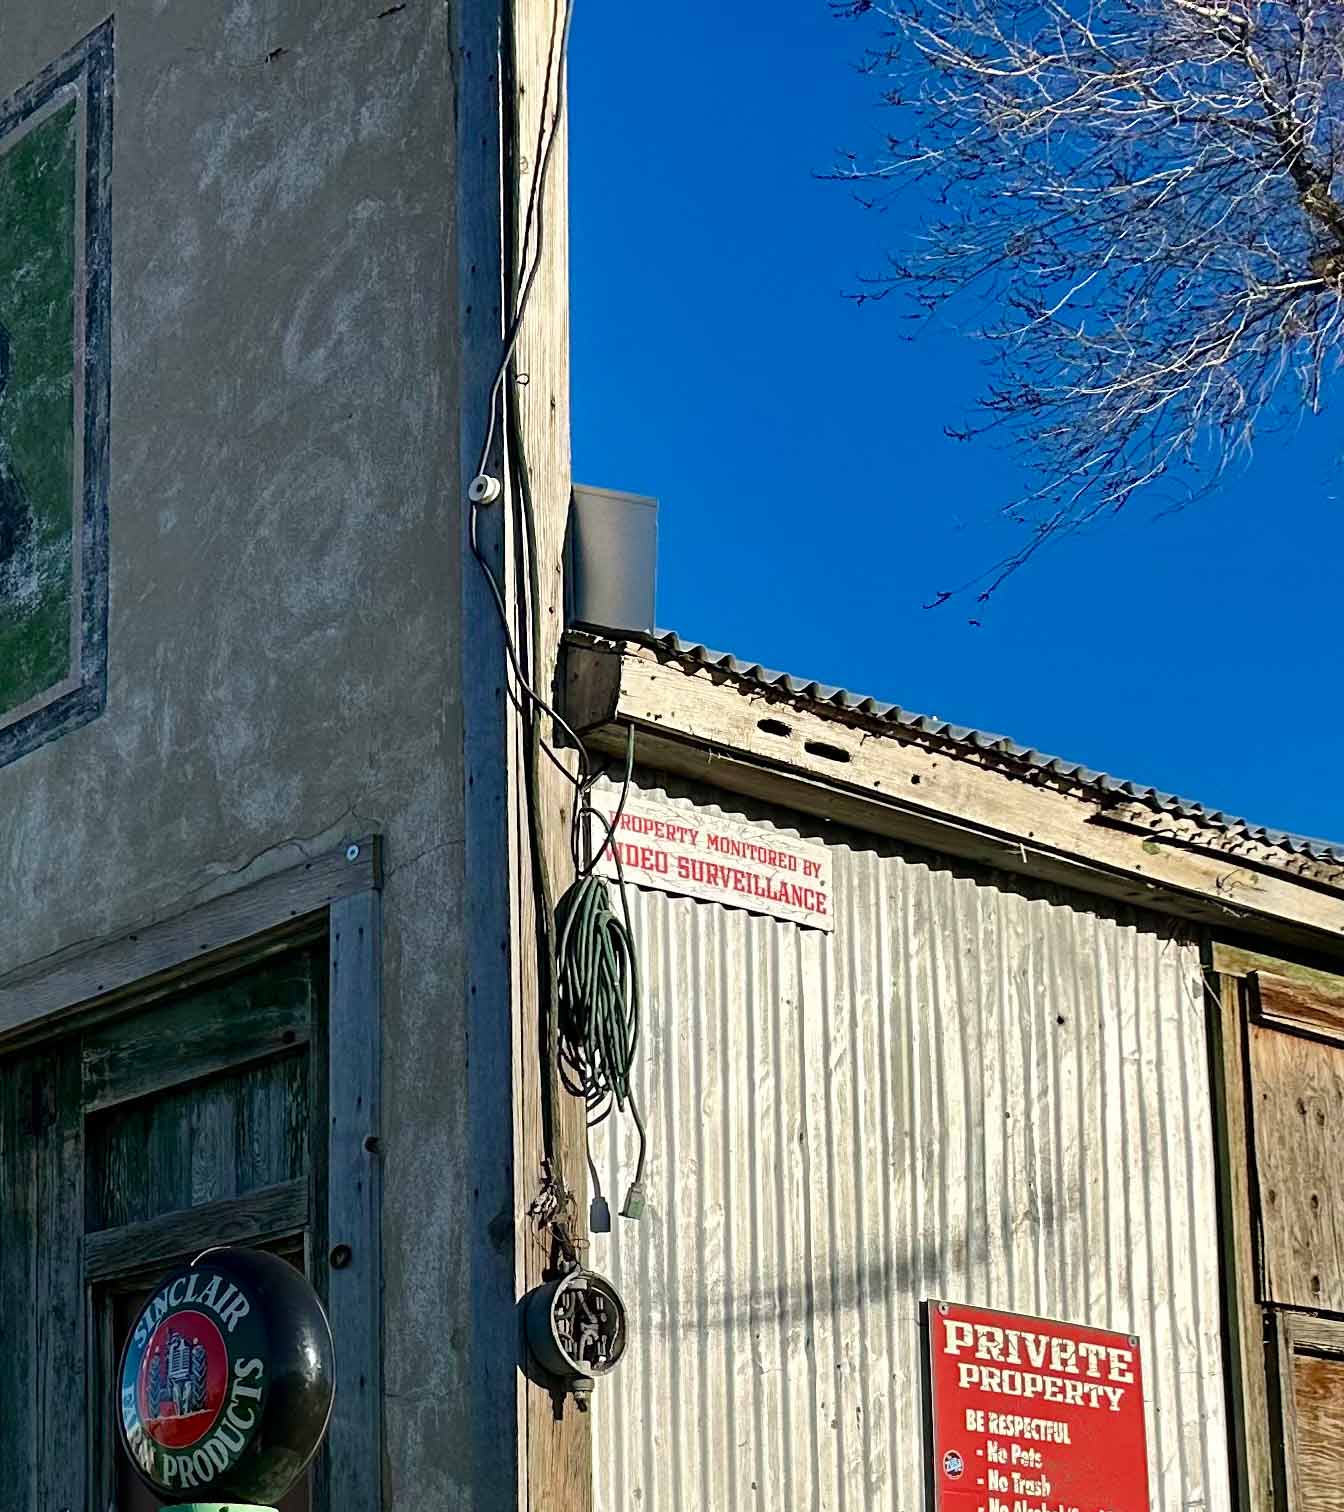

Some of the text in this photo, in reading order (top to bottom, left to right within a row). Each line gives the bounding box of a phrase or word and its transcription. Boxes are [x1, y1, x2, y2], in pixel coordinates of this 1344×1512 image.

[707, 833, 799, 873] MONITORED
[803, 858, 823, 879] BY
[677, 855, 827, 915] SURVEILLANCE
[133, 1273, 250, 1349] SINCLAIR
[943, 1319, 1135, 1384] PRIVATE
[958, 1362, 1125, 1411] PROPERTY
[162, 1358, 264, 1489] PRODUCTS
[965, 1408, 1072, 1445] BE RESPECTFUL
[987, 1440, 1008, 1465] No
[1011, 1444, 1043, 1469] Pets
[988, 1469, 1009, 1494] No
[1011, 1472, 1051, 1498] Trash
